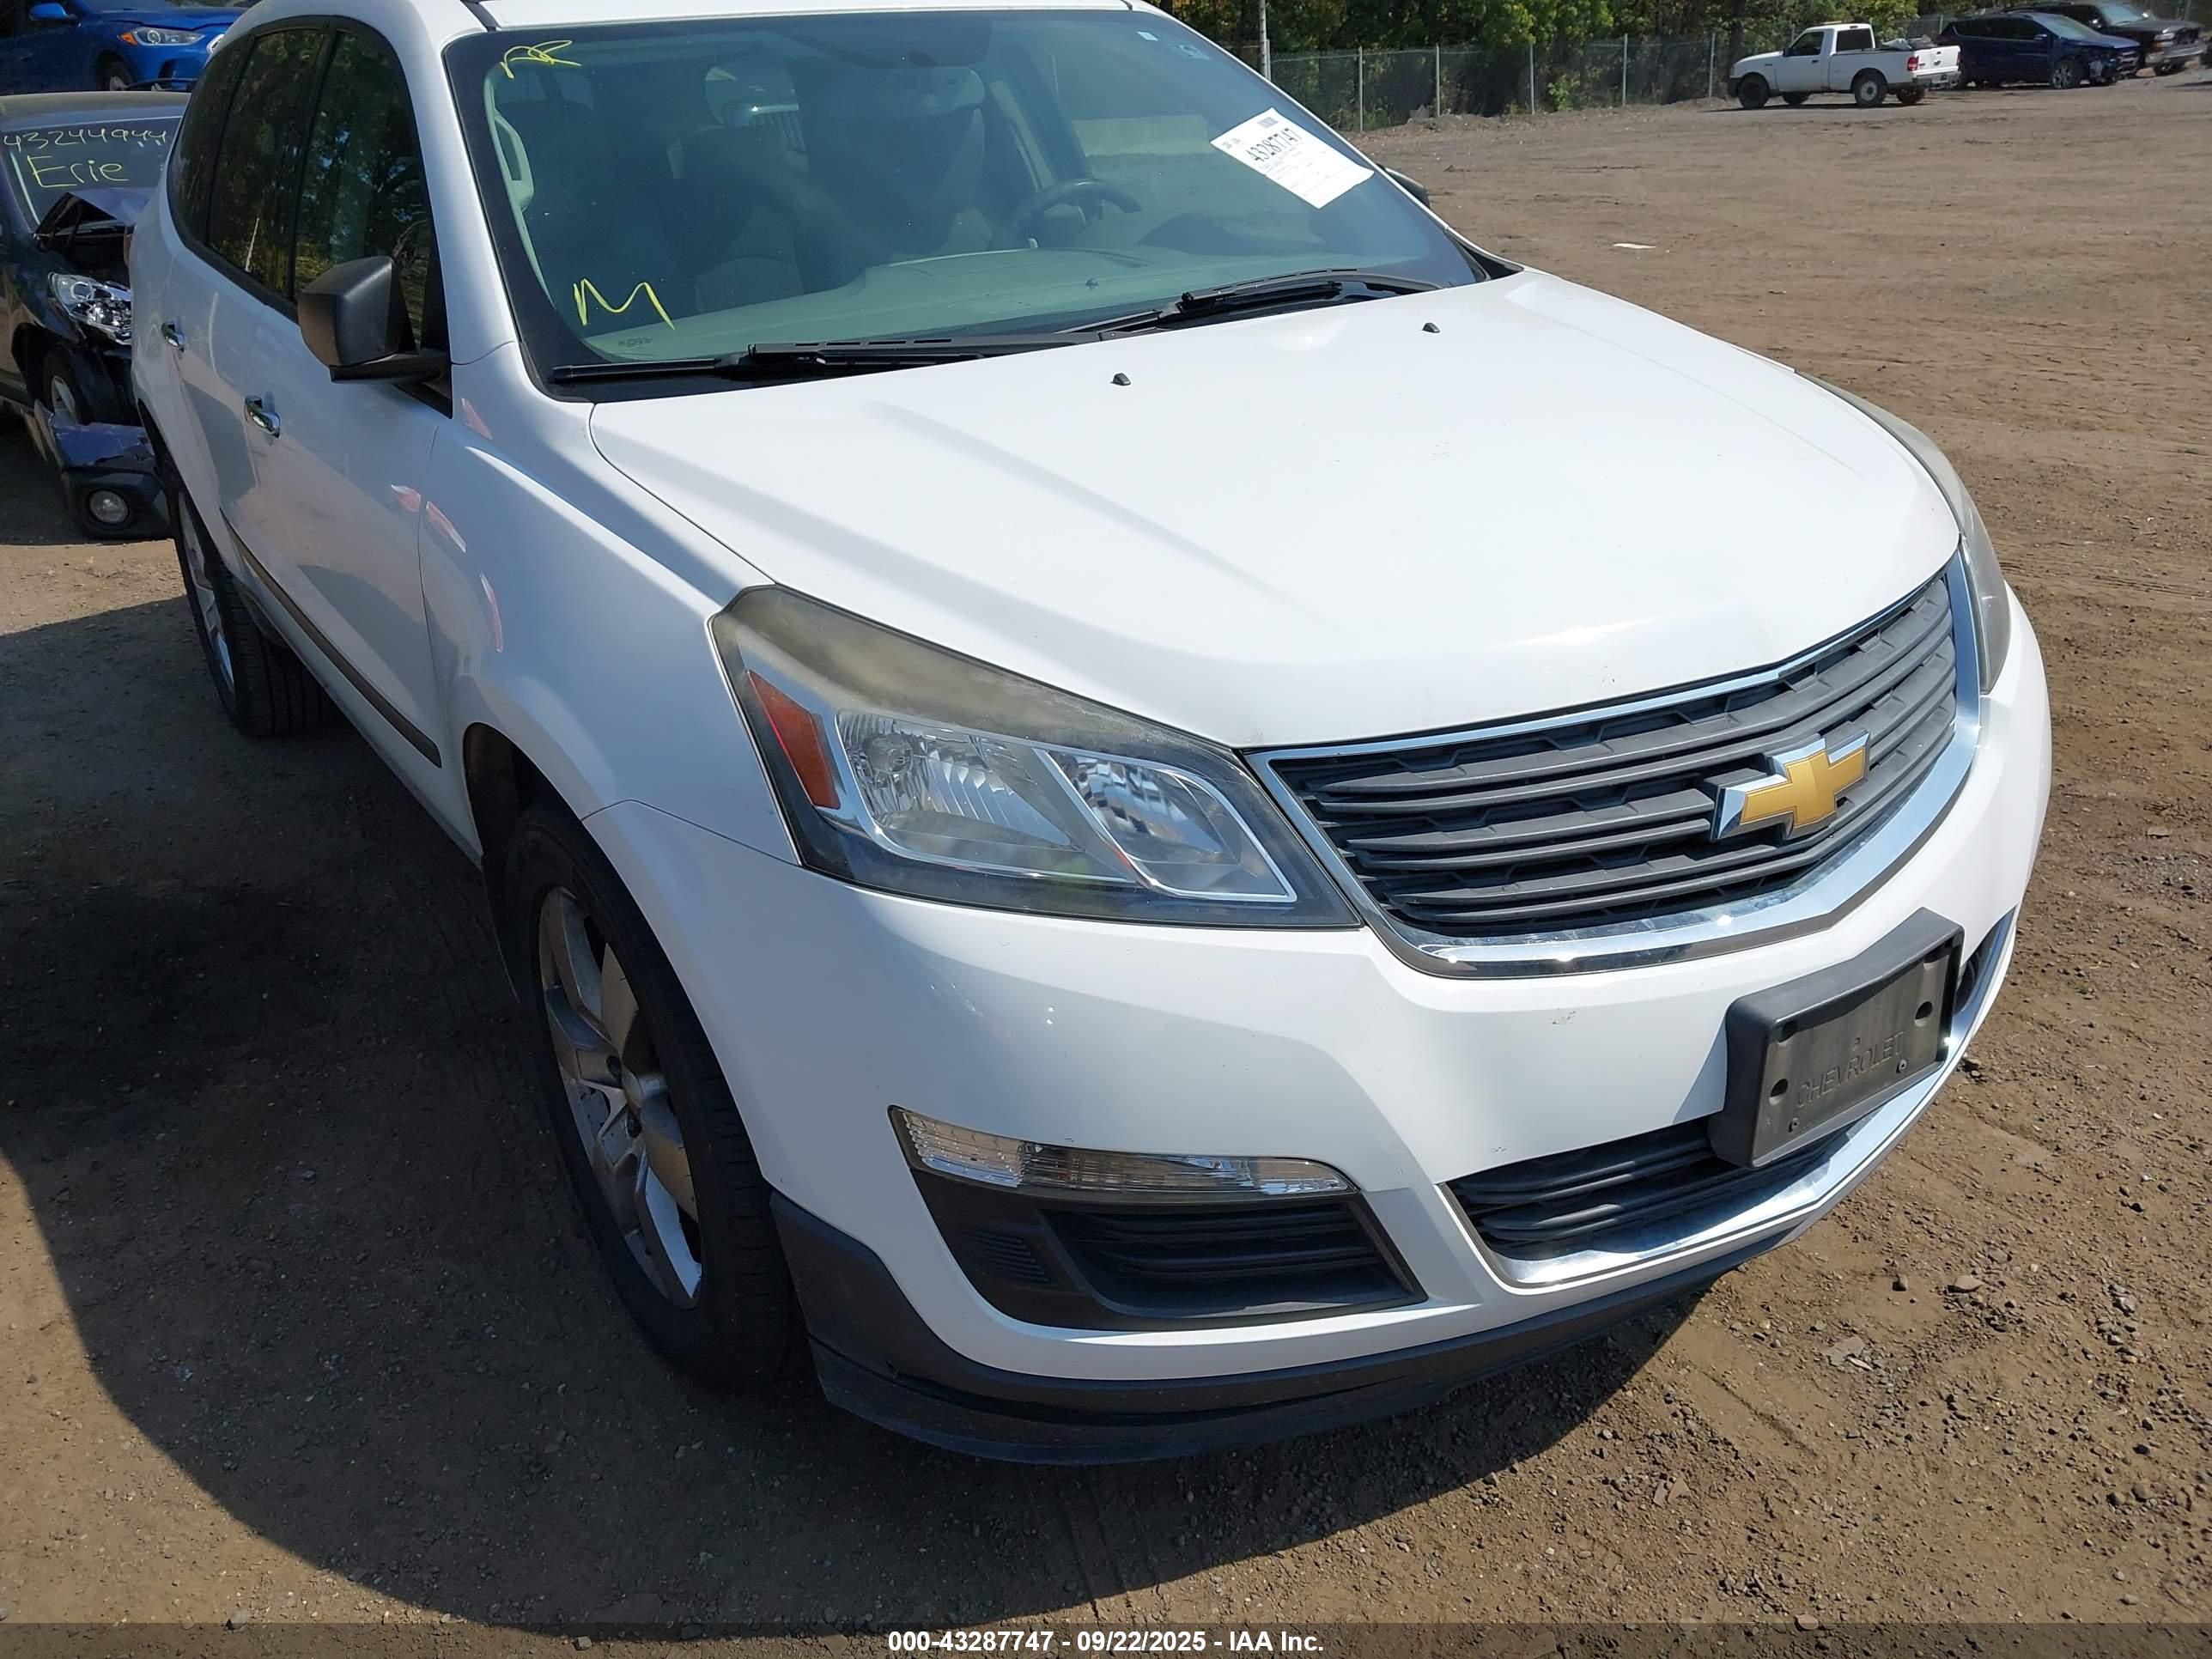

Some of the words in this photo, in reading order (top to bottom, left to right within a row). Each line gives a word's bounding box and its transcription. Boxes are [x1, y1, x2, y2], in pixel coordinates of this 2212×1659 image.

[3, 128, 167, 152] 43244944
[1246, 128, 1303, 161] 43287747
[27, 155, 130, 187] Erie
[573, 277, 676, 331] M
[1796, 1030, 1905, 1108] CHEVROLET
